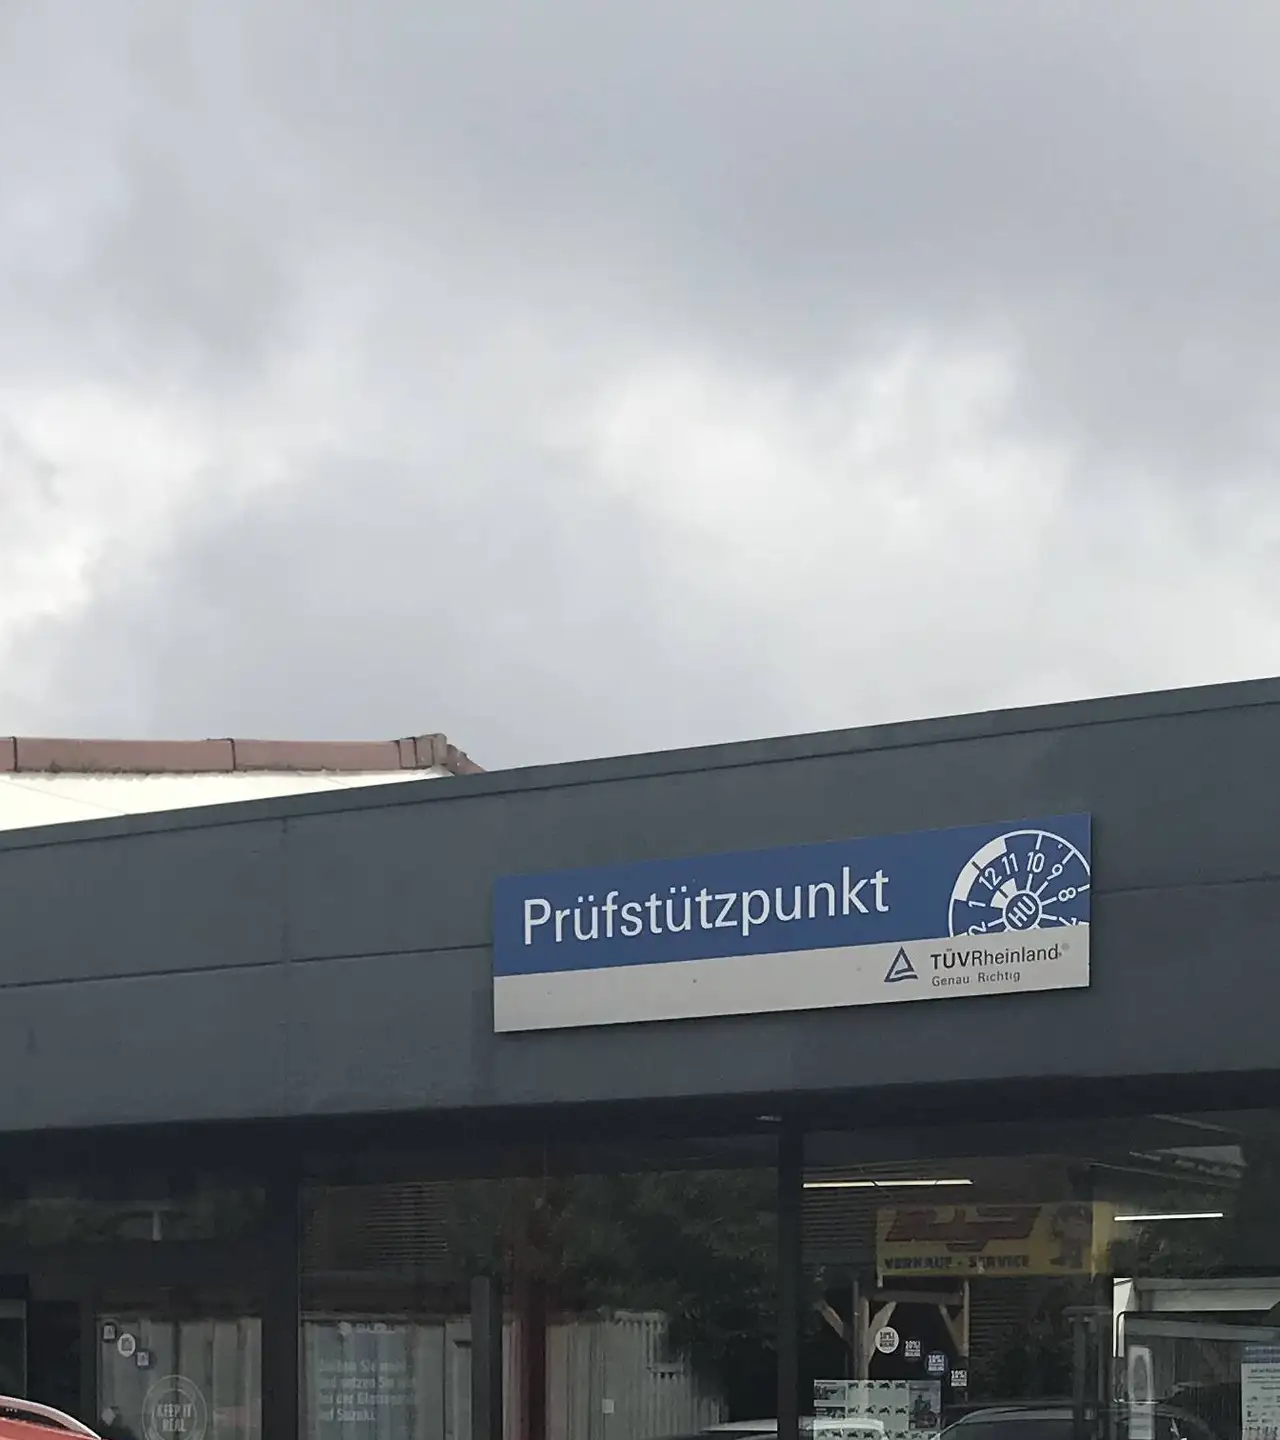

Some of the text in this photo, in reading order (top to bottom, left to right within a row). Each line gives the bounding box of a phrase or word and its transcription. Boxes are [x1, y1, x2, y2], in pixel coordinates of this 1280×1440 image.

[978, 867, 1002, 891] 12
[1001, 852, 1019, 876] 11
[1026, 851, 1045, 873] 10
[1046, 863, 1065, 880] 9
[1057, 886, 1077, 902] 8
[523, 866, 890, 946] Prüfstützpunkt
[1007, 895, 1037, 928] HU
[156, 1403, 181, 1418] KEEP
[162, 1418, 187, 1432] REAL
